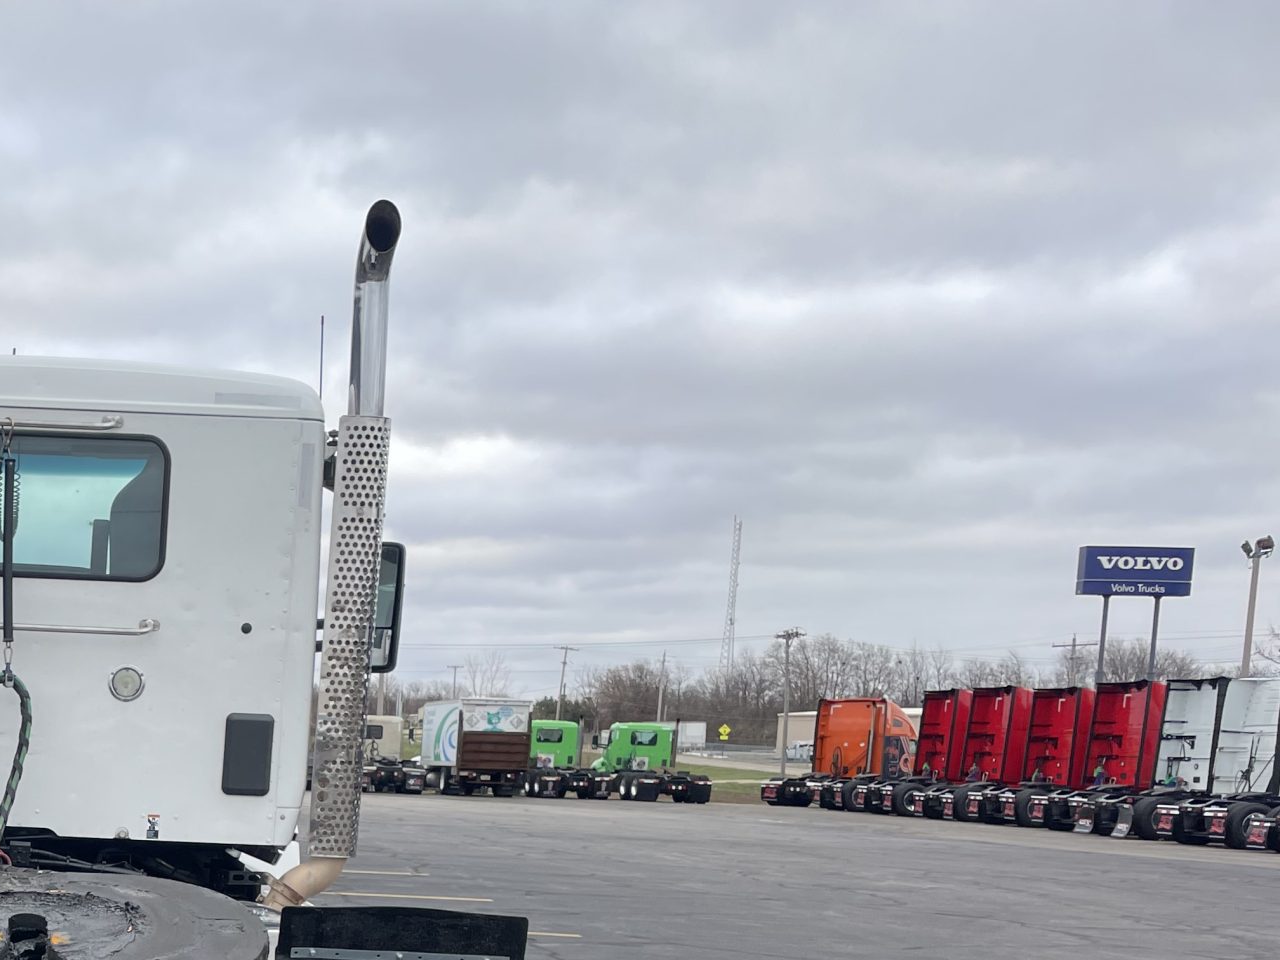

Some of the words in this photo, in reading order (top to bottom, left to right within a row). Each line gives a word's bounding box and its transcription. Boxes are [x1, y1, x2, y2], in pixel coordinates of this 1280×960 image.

[1097, 556, 1184, 571] VOLVO
[1111, 583, 1135, 594] Volvo
[1138, 583, 1166, 594] Trucks
